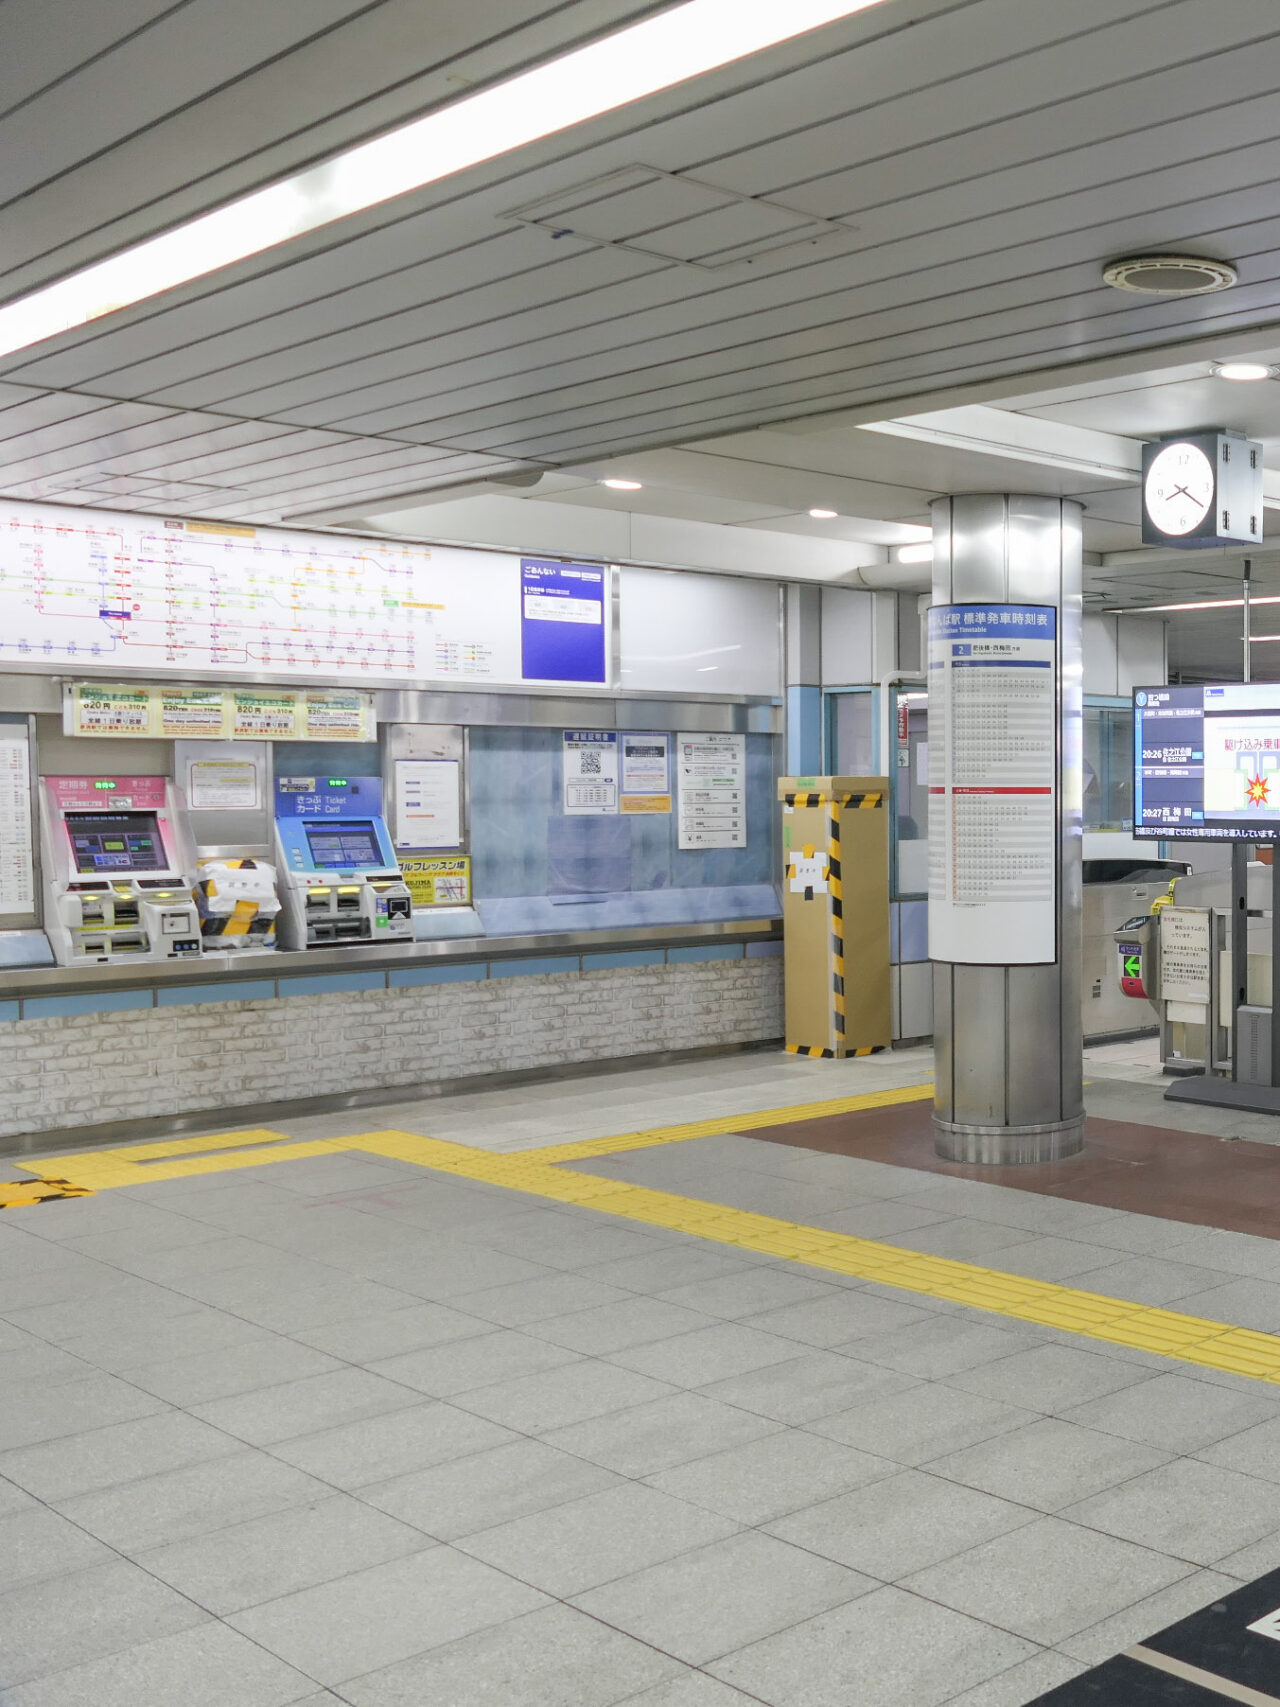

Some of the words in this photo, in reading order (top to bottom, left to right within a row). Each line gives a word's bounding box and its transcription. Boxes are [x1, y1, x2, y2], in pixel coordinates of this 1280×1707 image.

[964, 612, 1048, 626] 標準発車時刻表
[958, 646, 964, 654] 2
[1143, 750, 1163, 759] 20:26
[296, 795, 321, 804] きっぷ
[325, 796, 347, 804] Ticket
[297, 805, 321, 813] カード
[325, 805, 341, 813] Card
[1143, 808, 1162, 817] 20:27
